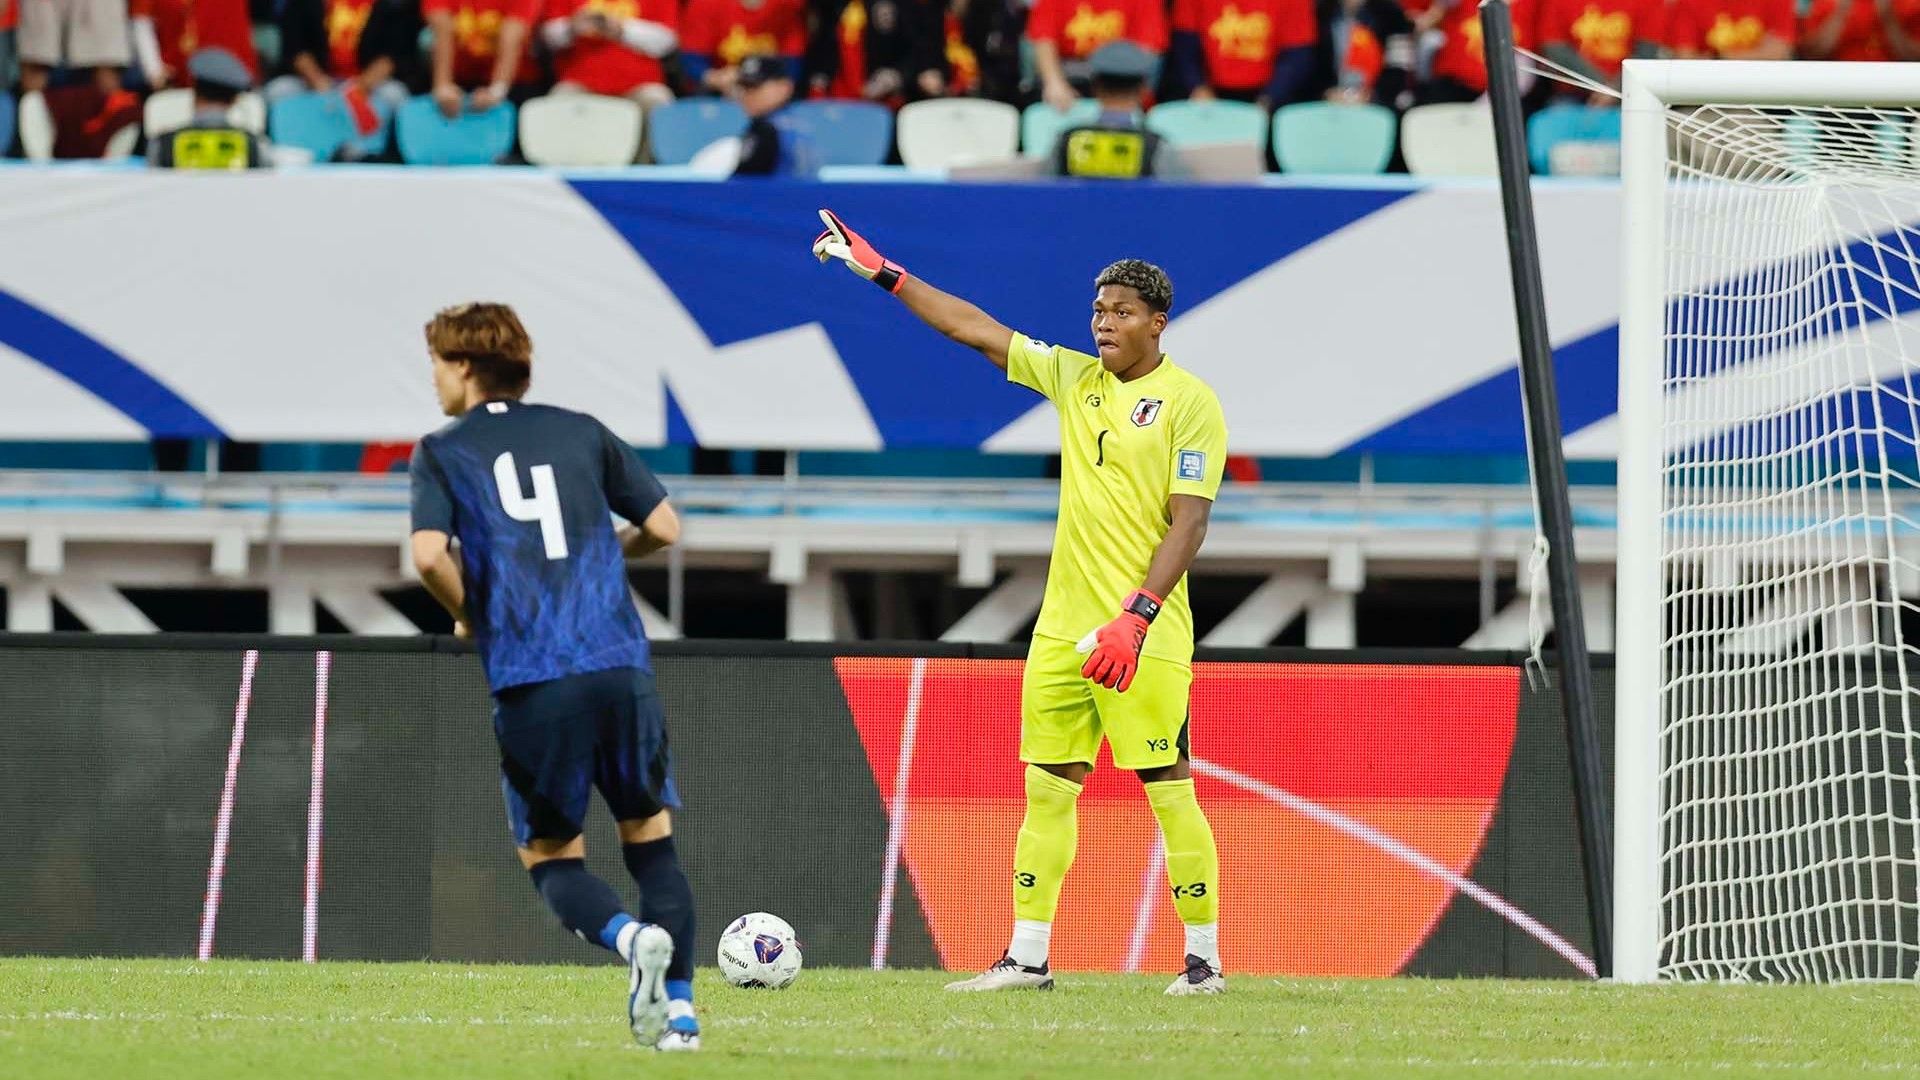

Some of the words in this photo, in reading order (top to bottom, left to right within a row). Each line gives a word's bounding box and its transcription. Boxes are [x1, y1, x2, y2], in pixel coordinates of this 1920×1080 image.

[493, 450, 570, 561] 4
[1146, 738, 1168, 752] Y-3
[1170, 883, 1206, 899] Y-3
[722, 949, 749, 970] molten
